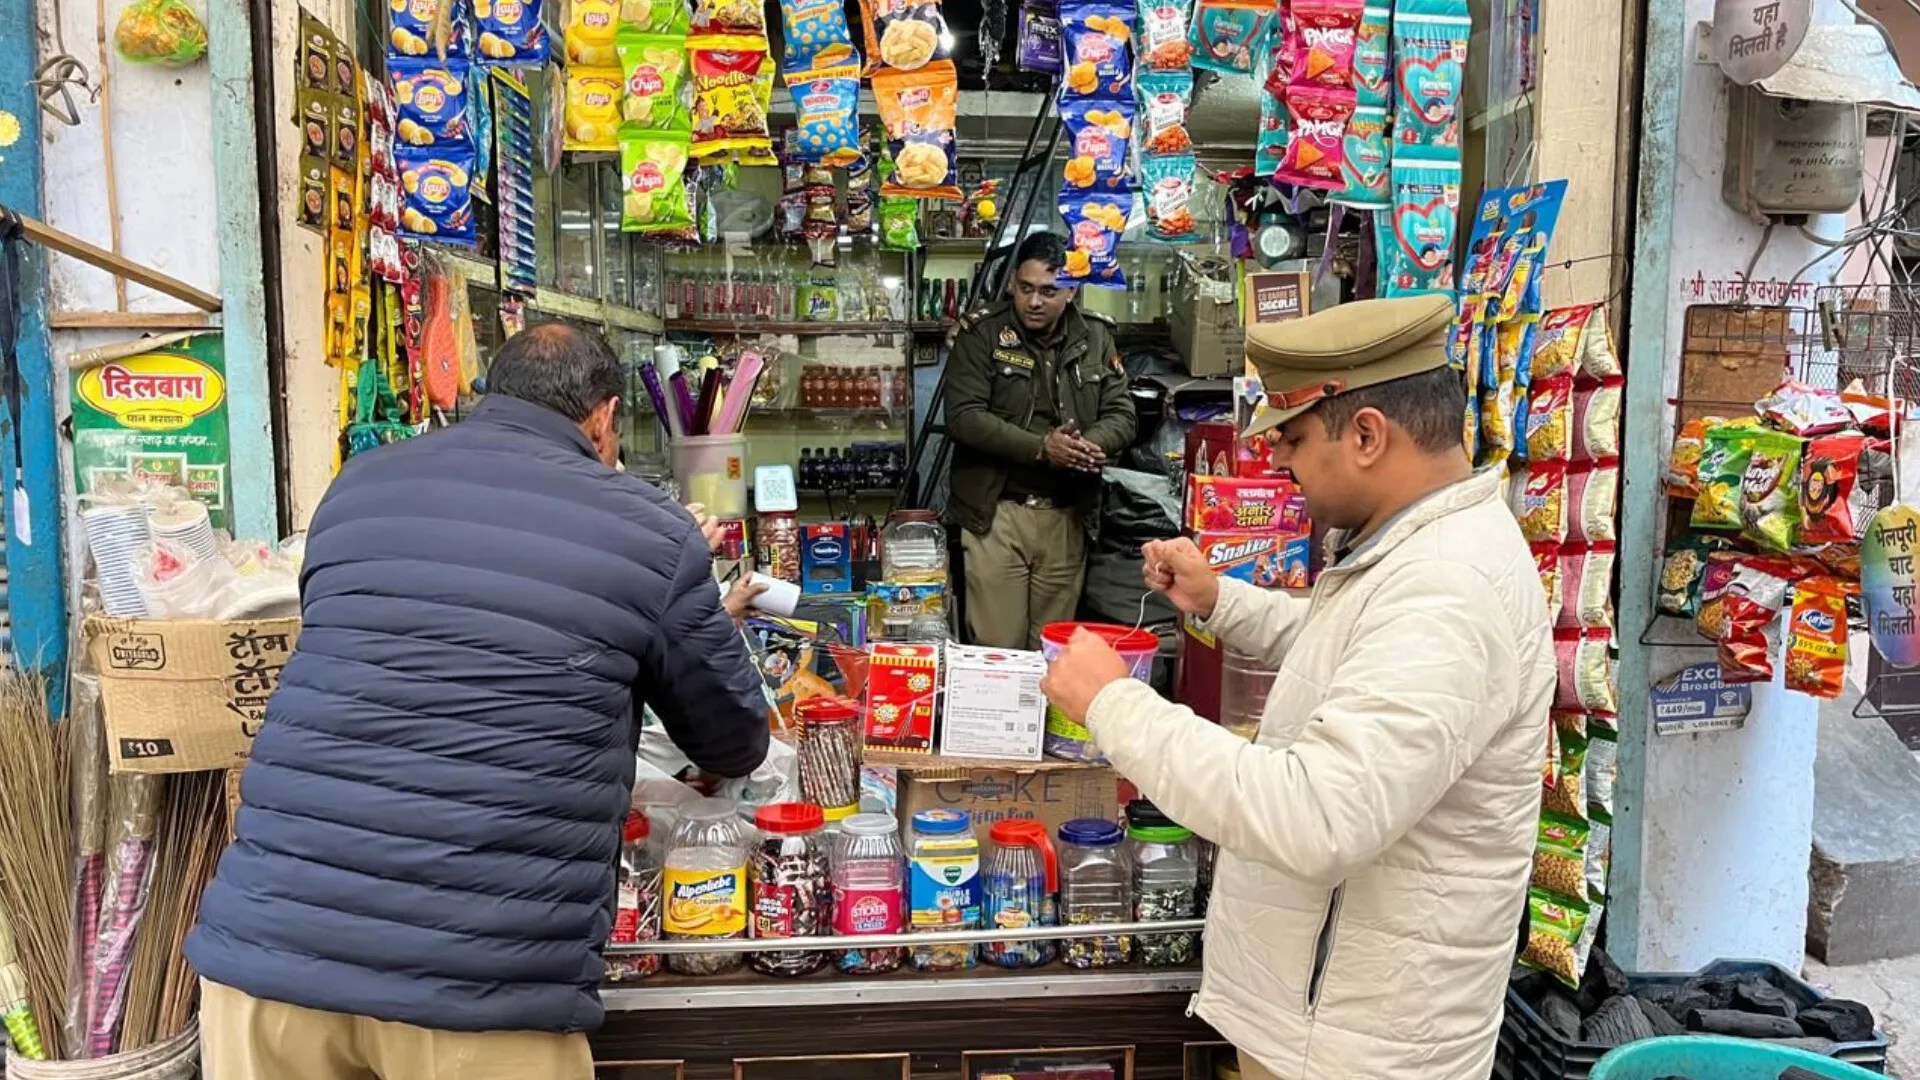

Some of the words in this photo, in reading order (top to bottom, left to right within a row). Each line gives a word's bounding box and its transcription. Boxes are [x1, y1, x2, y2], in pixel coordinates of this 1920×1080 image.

[1728, 26, 1773, 60] मिलती
[1776, 22, 1788, 51] है
[631, 77, 662, 92] Chips
[632, 173, 663, 189] Chips
[809, 296, 831, 313] Tide
[102, 364, 203, 399] दिलबाग
[1236, 515, 1270, 527] दाना
[1875, 518, 1917, 552] भेलपूरी
[1209, 537, 1275, 565] Snakker
[1888, 555, 1914, 576] चाट
[1892, 579, 1916, 608] यहां
[1878, 611, 1915, 636] मिलती
[225, 628, 289, 660] टॉम
[677, 874, 732, 897] Alpenliebe
